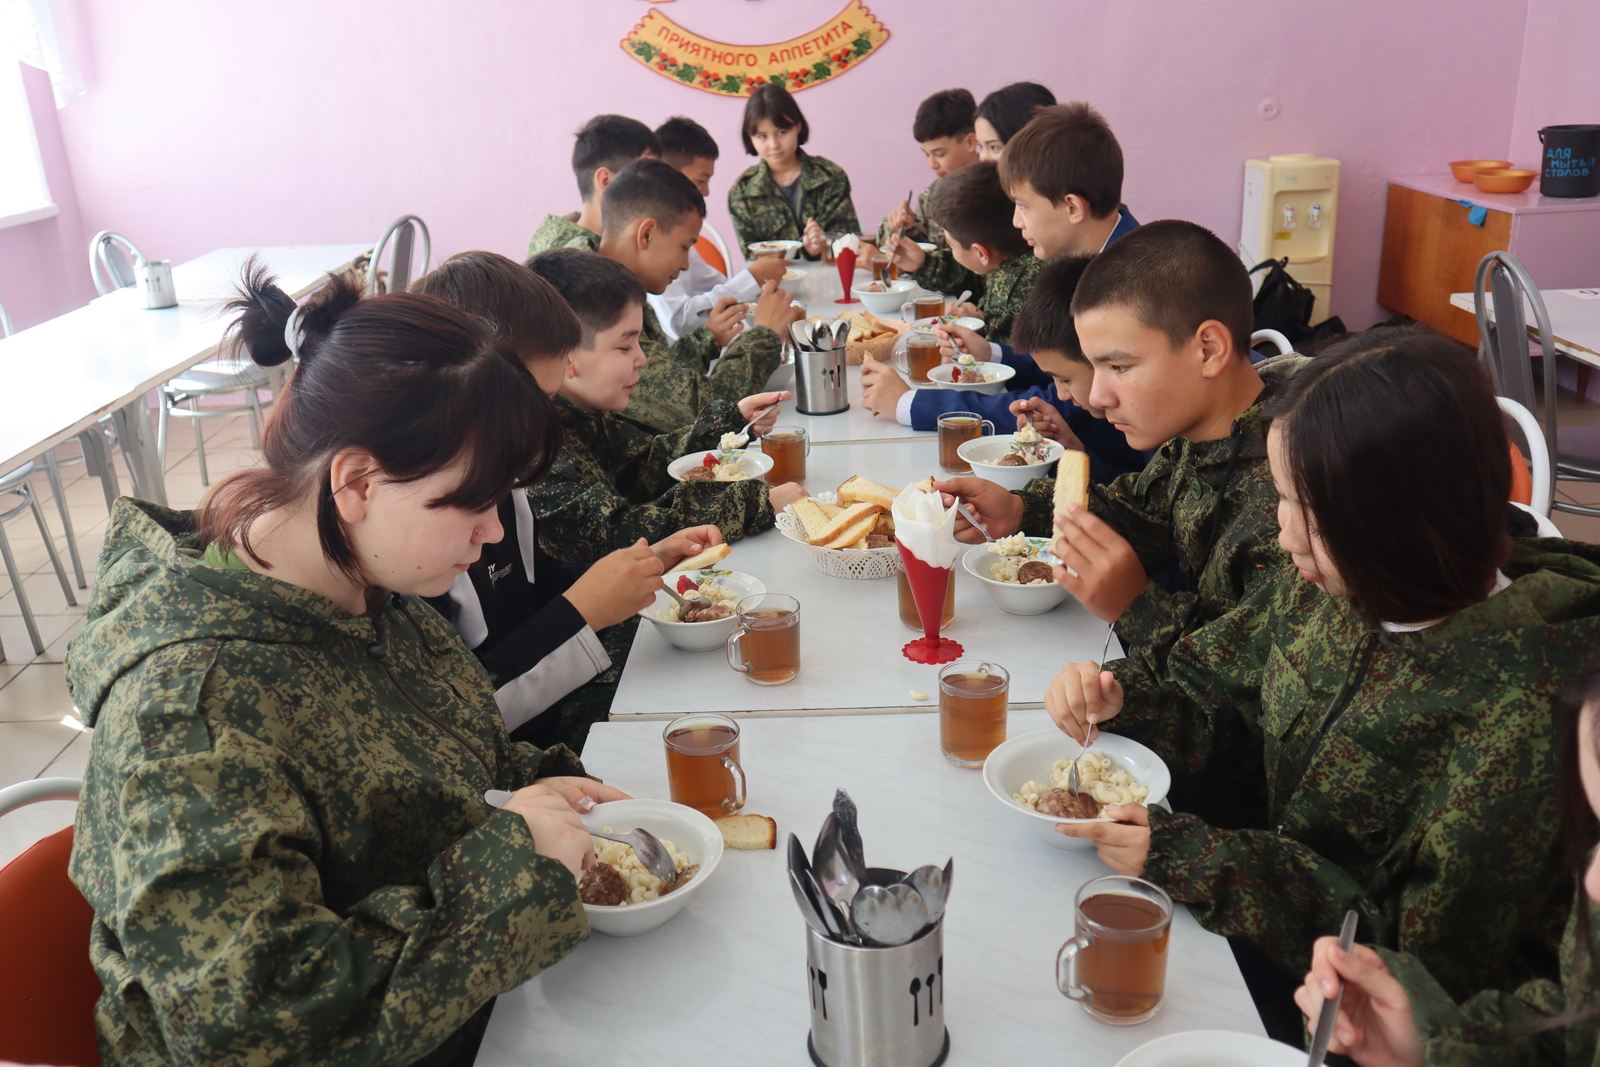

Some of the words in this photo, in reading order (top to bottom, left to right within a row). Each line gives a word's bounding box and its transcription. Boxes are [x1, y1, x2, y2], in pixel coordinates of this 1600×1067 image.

[656, 26, 758, 67] ПРИЯТНОГО
[768, 20, 854, 65] АППЕТИТА
[1546, 148, 1572, 159] ДЛЯ
[1551, 158, 1595, 168] МЫТЬЯ
[1545, 168, 1590, 177] СТОЛОВ
